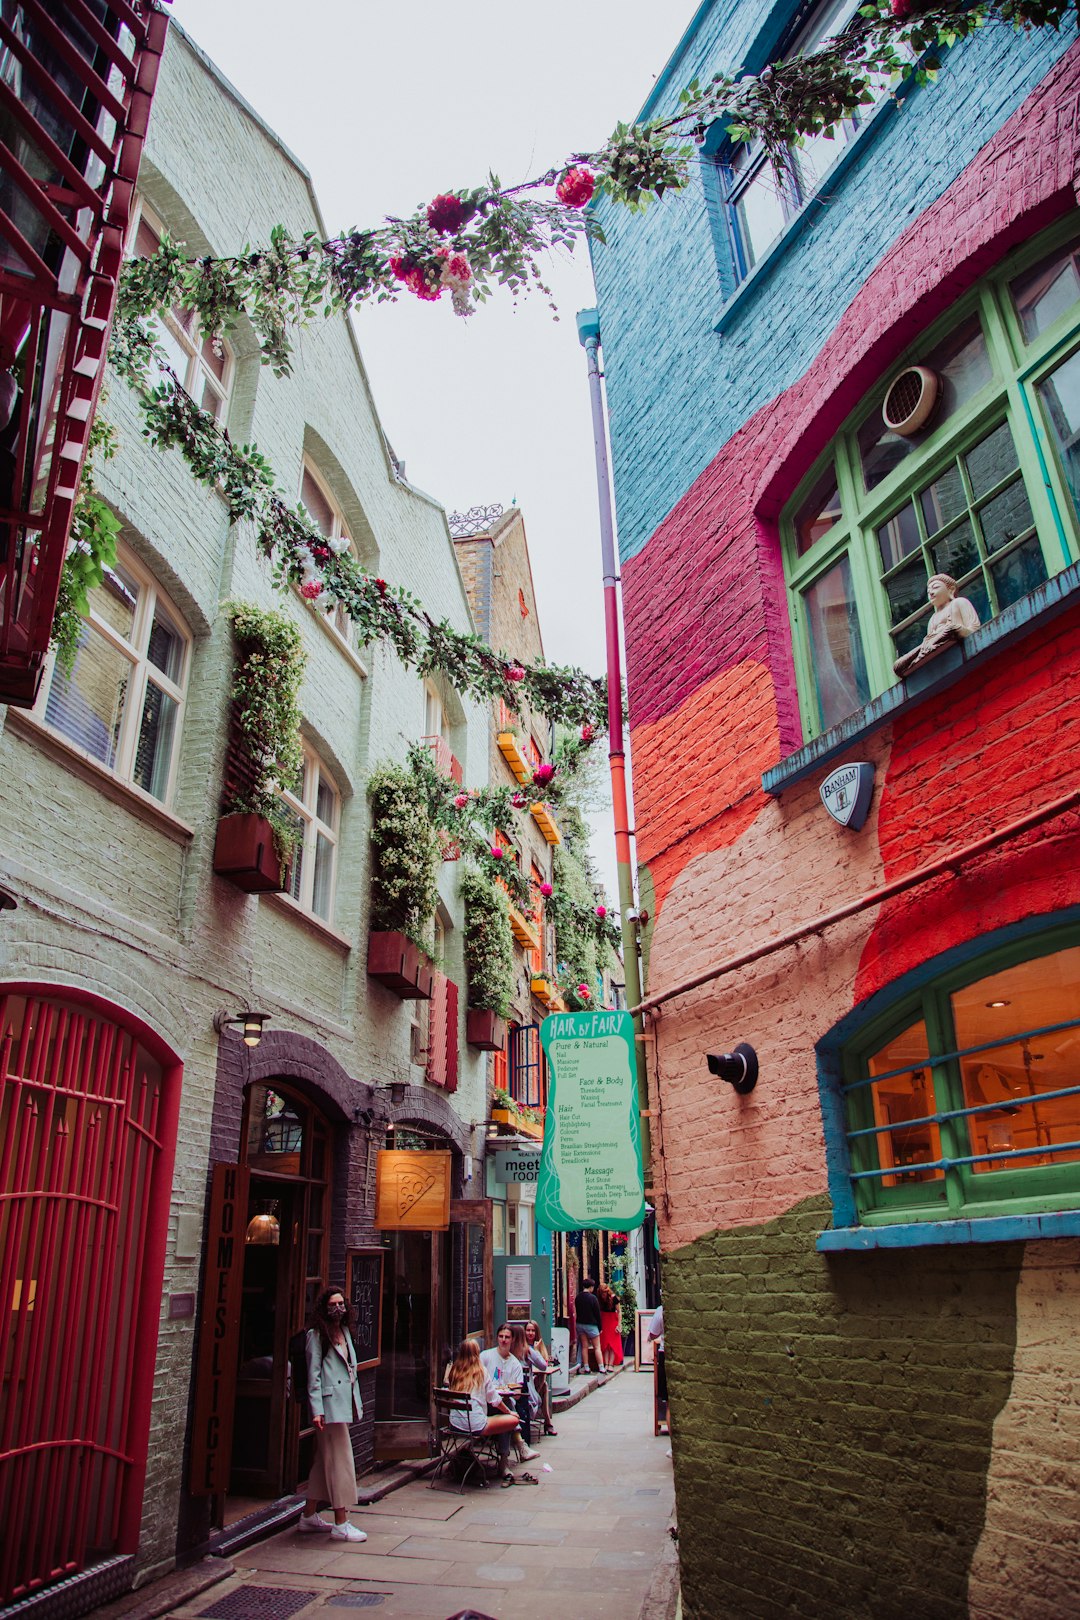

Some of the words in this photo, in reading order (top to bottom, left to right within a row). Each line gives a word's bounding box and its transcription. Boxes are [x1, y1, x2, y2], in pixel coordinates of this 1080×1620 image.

[824, 769, 856, 798] BANHAM
[550, 1015, 576, 1040] HAIR
[579, 1022, 590, 1037] BY
[591, 1014, 624, 1037] FAIRY
[555, 1042, 571, 1050] Pure
[574, 1041, 580, 1049] &
[583, 1040, 608, 1048] Natural
[579, 1078, 594, 1086] Face
[597, 1076, 603, 1085] &
[606, 1076, 624, 1086] Body
[558, 1105, 573, 1113] Hair
[505, 1159, 539, 1170] meet
[584, 1167, 614, 1176] Massage
[355, 1284, 372, 1304] BACK
